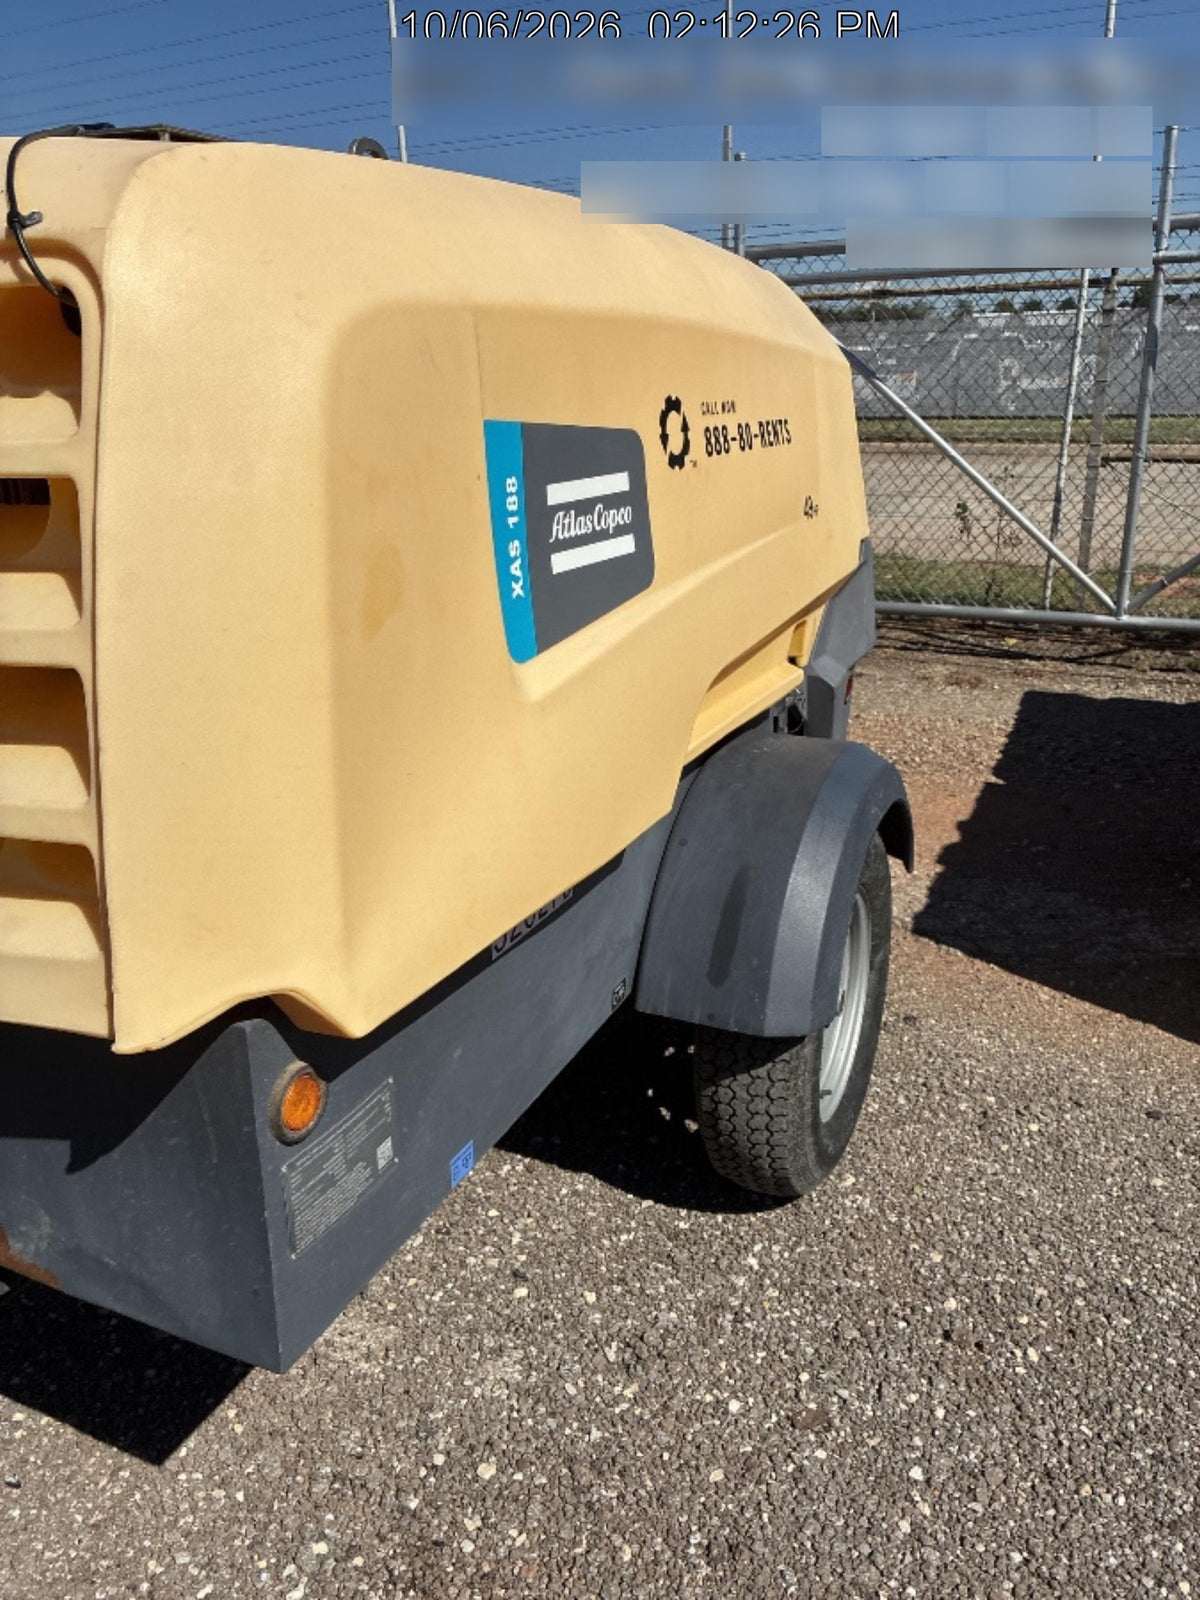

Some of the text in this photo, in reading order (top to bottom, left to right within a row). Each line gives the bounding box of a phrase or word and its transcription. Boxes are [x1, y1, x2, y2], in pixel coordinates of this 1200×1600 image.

[704, 418, 792, 458] 888-80-RENTS
[506, 475, 526, 599] XAS 188
